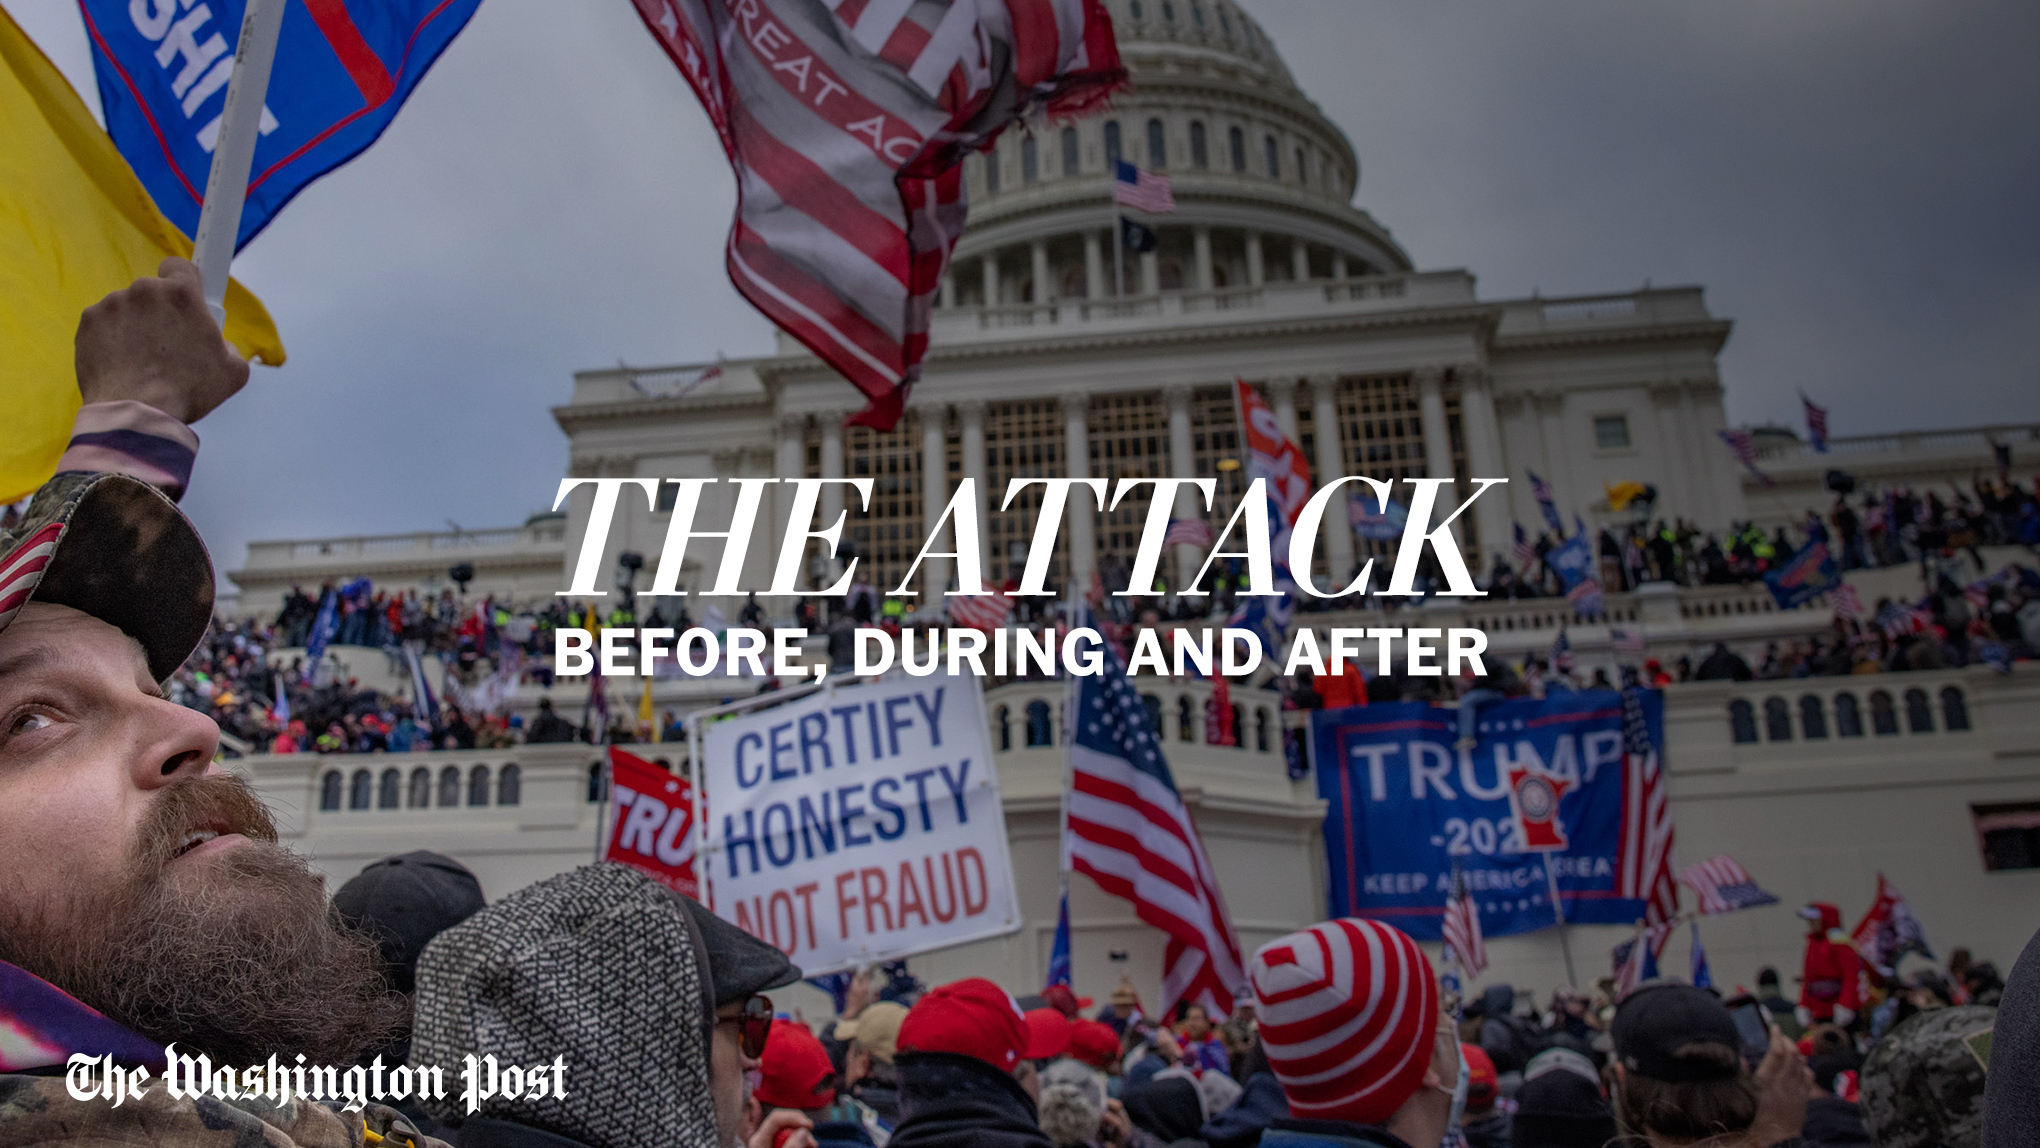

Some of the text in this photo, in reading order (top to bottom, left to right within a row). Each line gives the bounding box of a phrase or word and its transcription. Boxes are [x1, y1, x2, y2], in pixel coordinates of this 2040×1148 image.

[734, 685, 945, 790] CERTIFY
[1350, 729, 1625, 801] TRUMP
[614, 783, 706, 870] TRU
[723, 758, 972, 879] HONESTY
[735, 847, 990, 957] NOT FRAUD
